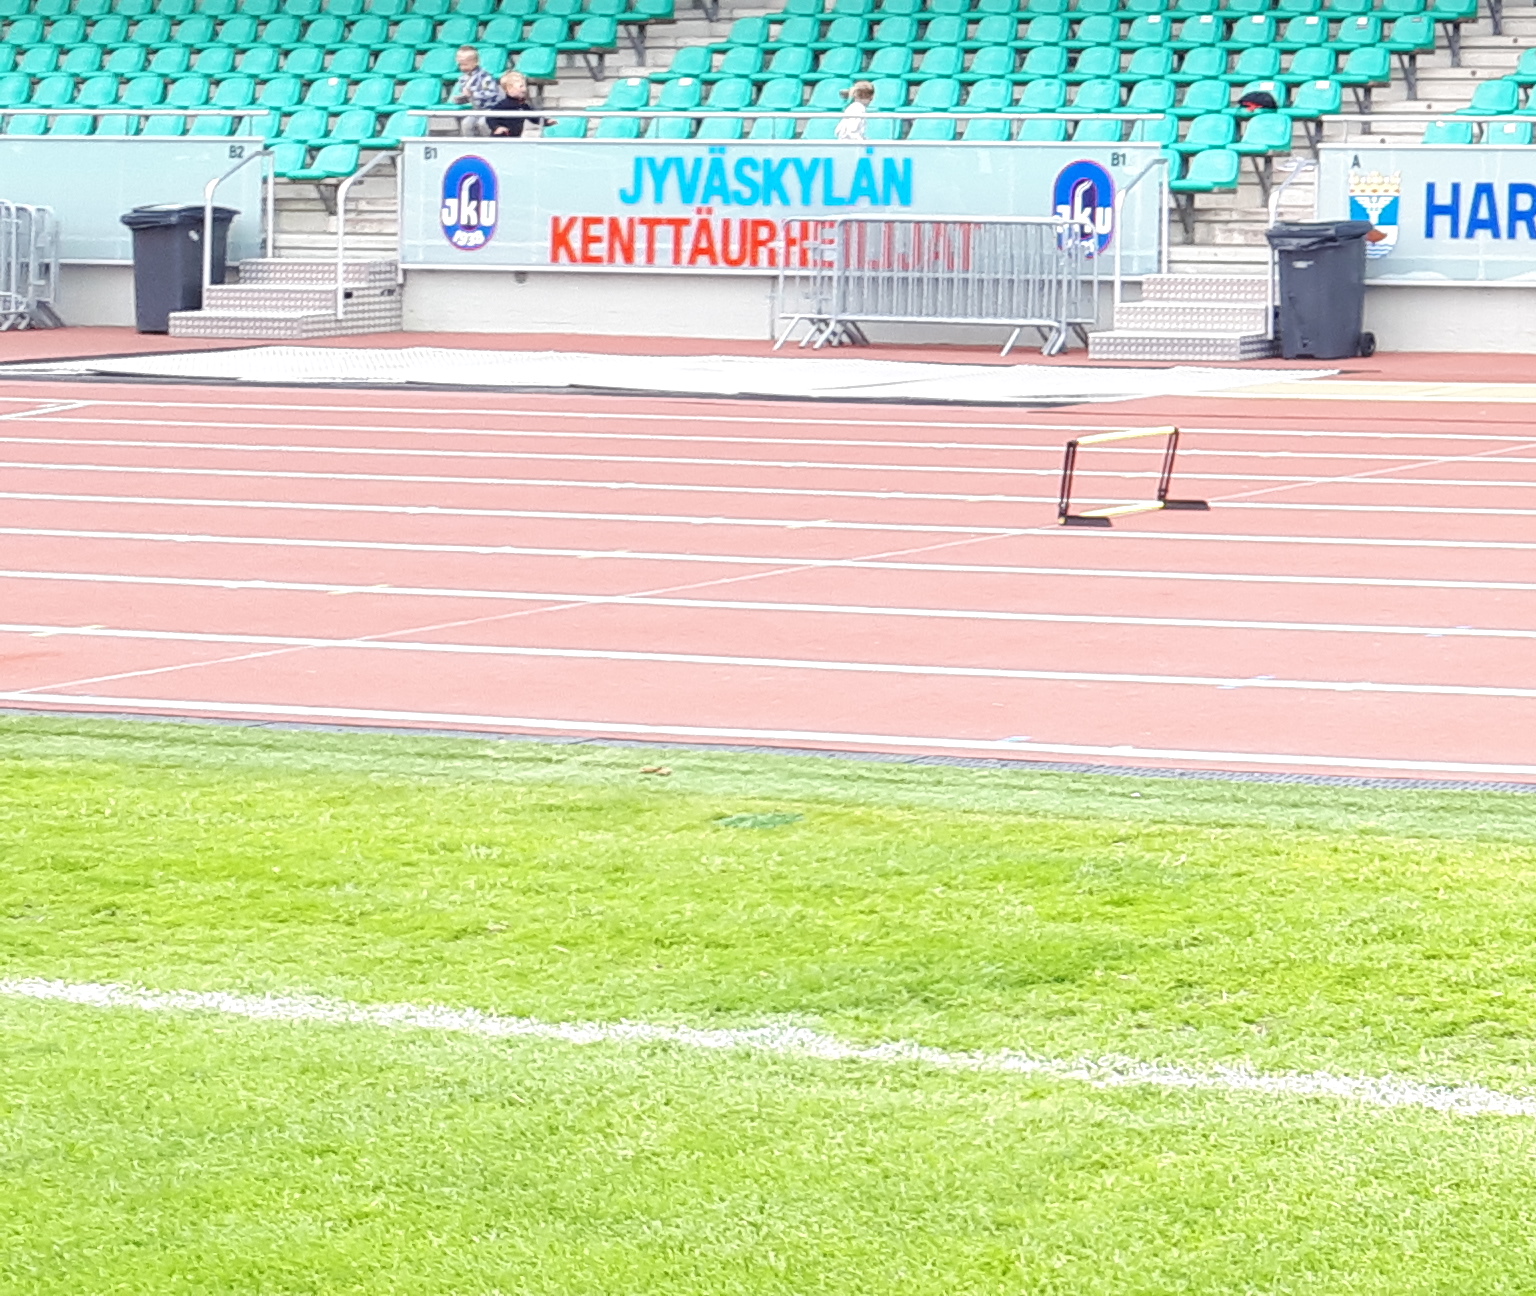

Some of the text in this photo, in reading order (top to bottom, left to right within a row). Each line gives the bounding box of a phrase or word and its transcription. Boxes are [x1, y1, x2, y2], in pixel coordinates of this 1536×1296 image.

[229, 145, 244, 159] B2
[1111, 152, 1126, 166] B1
[1351, 154, 1361, 168] A
